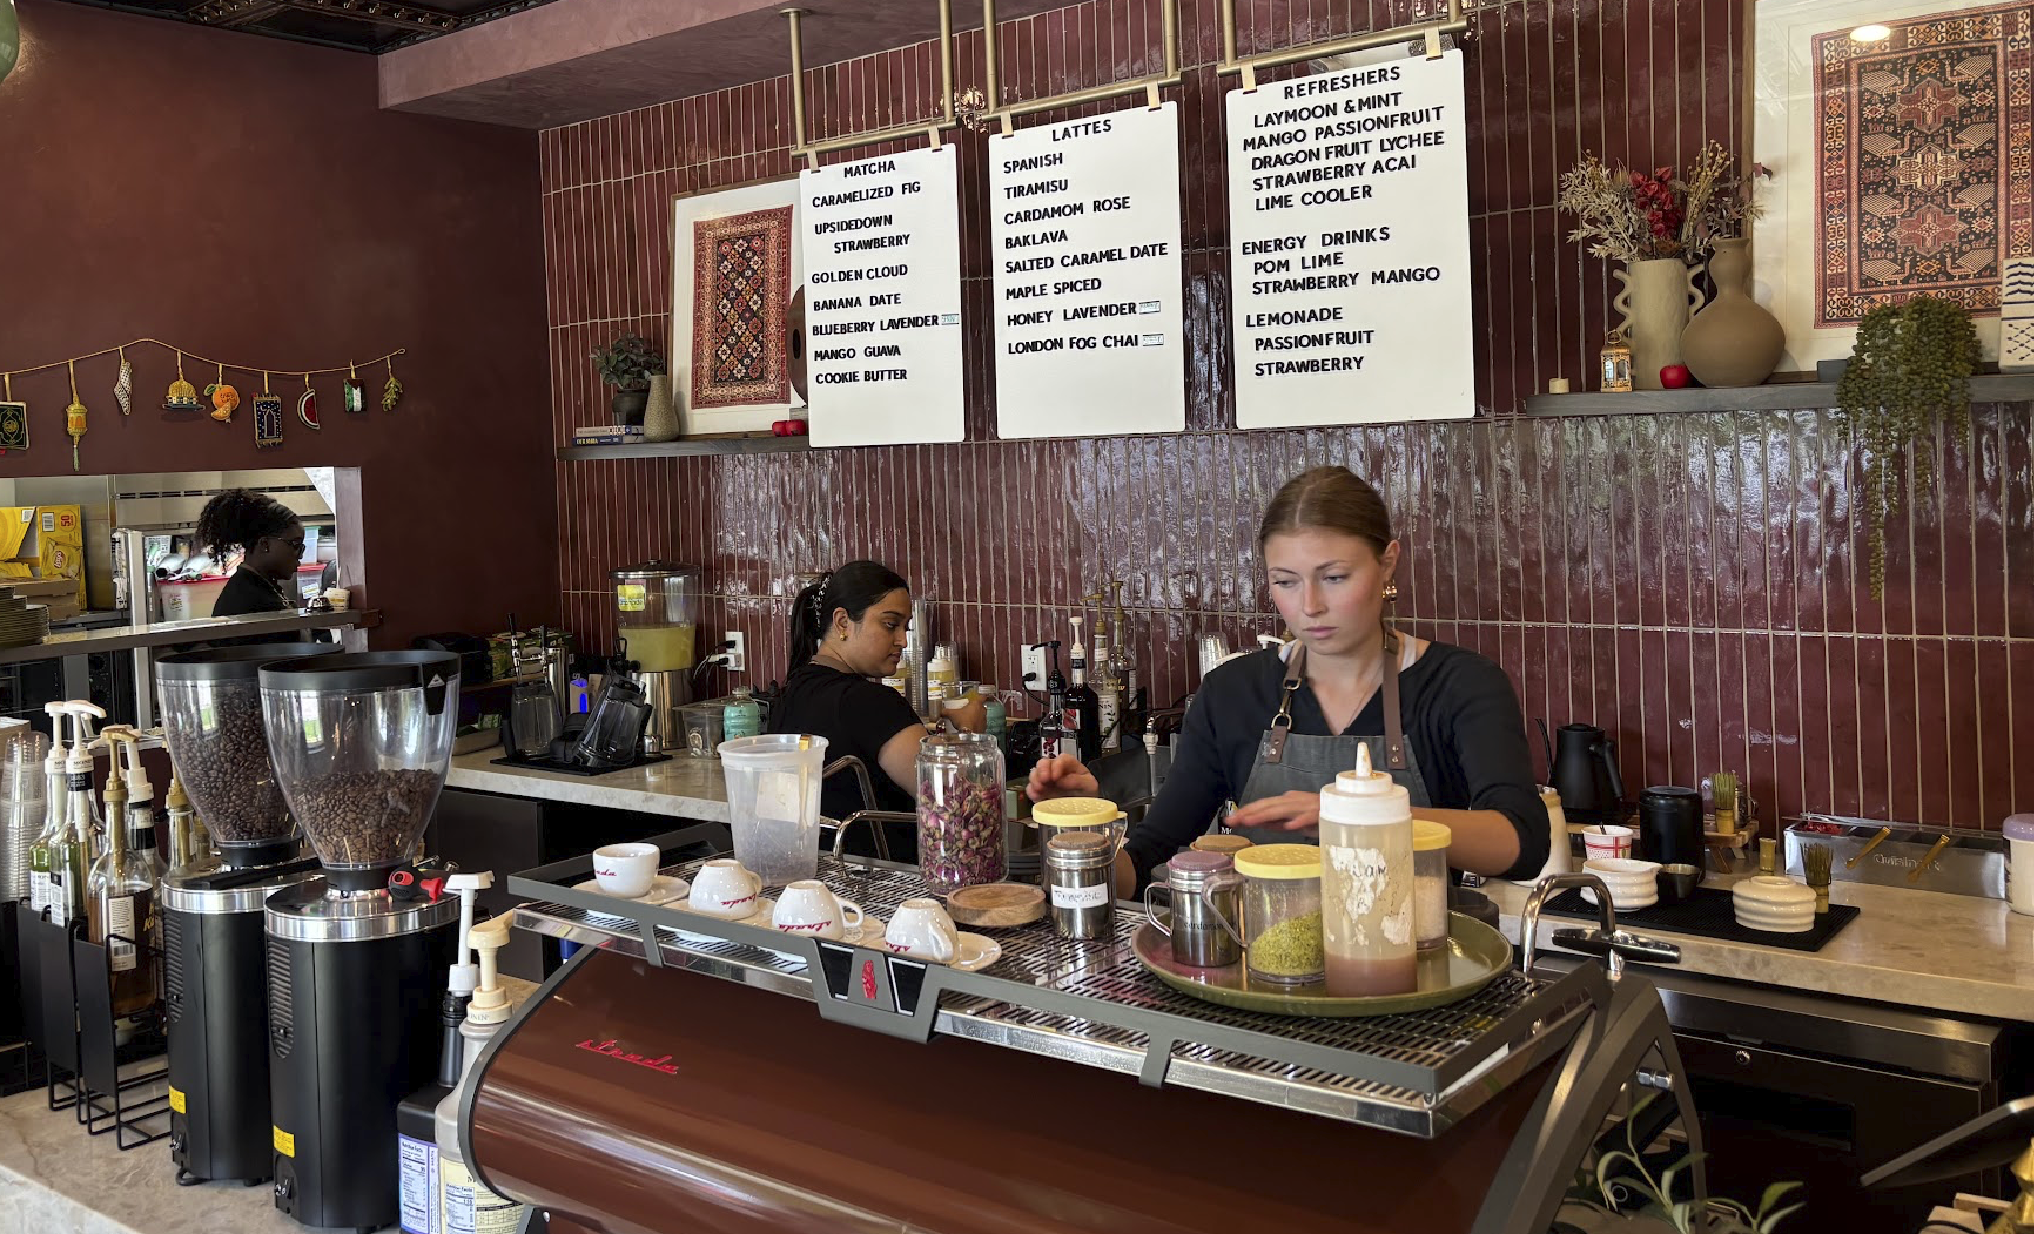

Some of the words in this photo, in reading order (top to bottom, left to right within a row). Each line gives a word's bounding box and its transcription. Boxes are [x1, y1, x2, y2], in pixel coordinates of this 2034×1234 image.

[1284, 66, 1401, 100] REFRESHERS
[1255, 102, 1337, 128] LAYMOON
[1344, 100, 1356, 113] &
[1358, 92, 1401, 112] MINT
[1053, 120, 1111, 141] LATTES
[1243, 129, 1306, 152] MANGO
[1315, 106, 1444, 141] PASSIONFRUIT
[1252, 148, 1319, 170] DRAGON
[1325, 140, 1372, 160] FRUIT
[1380, 132, 1444, 152] LYCHEE
[845, 161, 895, 177] MATCHA
[1004, 153, 1062, 174] SPANISH
[1253, 162, 1366, 191] STRAWBERRY
[1372, 155, 1416, 174] ACAI
[813, 186, 893, 207] CARAMELIZED
[902, 182, 920, 194] FIG
[1004, 180, 1068, 199] TIRAMISU
[1256, 195, 1293, 210] LIME
[1302, 186, 1372, 206] COOLER
[1004, 203, 1083, 224] CARDAMOM
[1094, 196, 1130, 211] ROSE
[815, 215, 892, 235] UPSIDEDOWN
[834, 234, 910, 254] STRAWBERRY
[1006, 230, 1068, 249] BAKLAVA
[1243, 236, 1306, 255] ENERGY
[1322, 227, 1390, 247] DRINKS
[1006, 257, 1054, 273] SALTED
[1061, 249, 1127, 267] CARAMEL
[1131, 243, 1168, 258] DATE
[1255, 260, 1289, 275] POM
[1302, 253, 1343, 269] LIME
[812, 269, 862, 283] GOLDEN
[867, 264, 908, 280] CLOUD
[1253, 273, 1359, 295] STRAWBERRY
[1372, 267, 1440, 284] MANGO
[1007, 284, 1048, 300] MAPLE
[1054, 278, 1101, 295] SPICED
[814, 297, 861, 311] BANANA
[870, 294, 901, 307] DATE
[813, 322, 875, 336] BLUEBERRY
[880, 315, 939, 330] LAVENDER
[1008, 310, 1053, 327] HONEY
[1063, 303, 1136, 321] LAVENDER
[1246, 307, 1343, 327] LEMONADE
[1009, 338, 1063, 354] LONDON
[1069, 337, 1096, 349] FOG
[1103, 335, 1138, 348] CHAI
[1255, 330, 1374, 351] PASSIONFRUIT
[814, 348, 855, 361] MANGO
[865, 345, 901, 357] GUAVA
[816, 371, 859, 384] COOKIE
[865, 369, 907, 382] BUTTER
[1255, 356, 1364, 376] STRAWBERRY
[576, 1039, 679, 1074] strada
